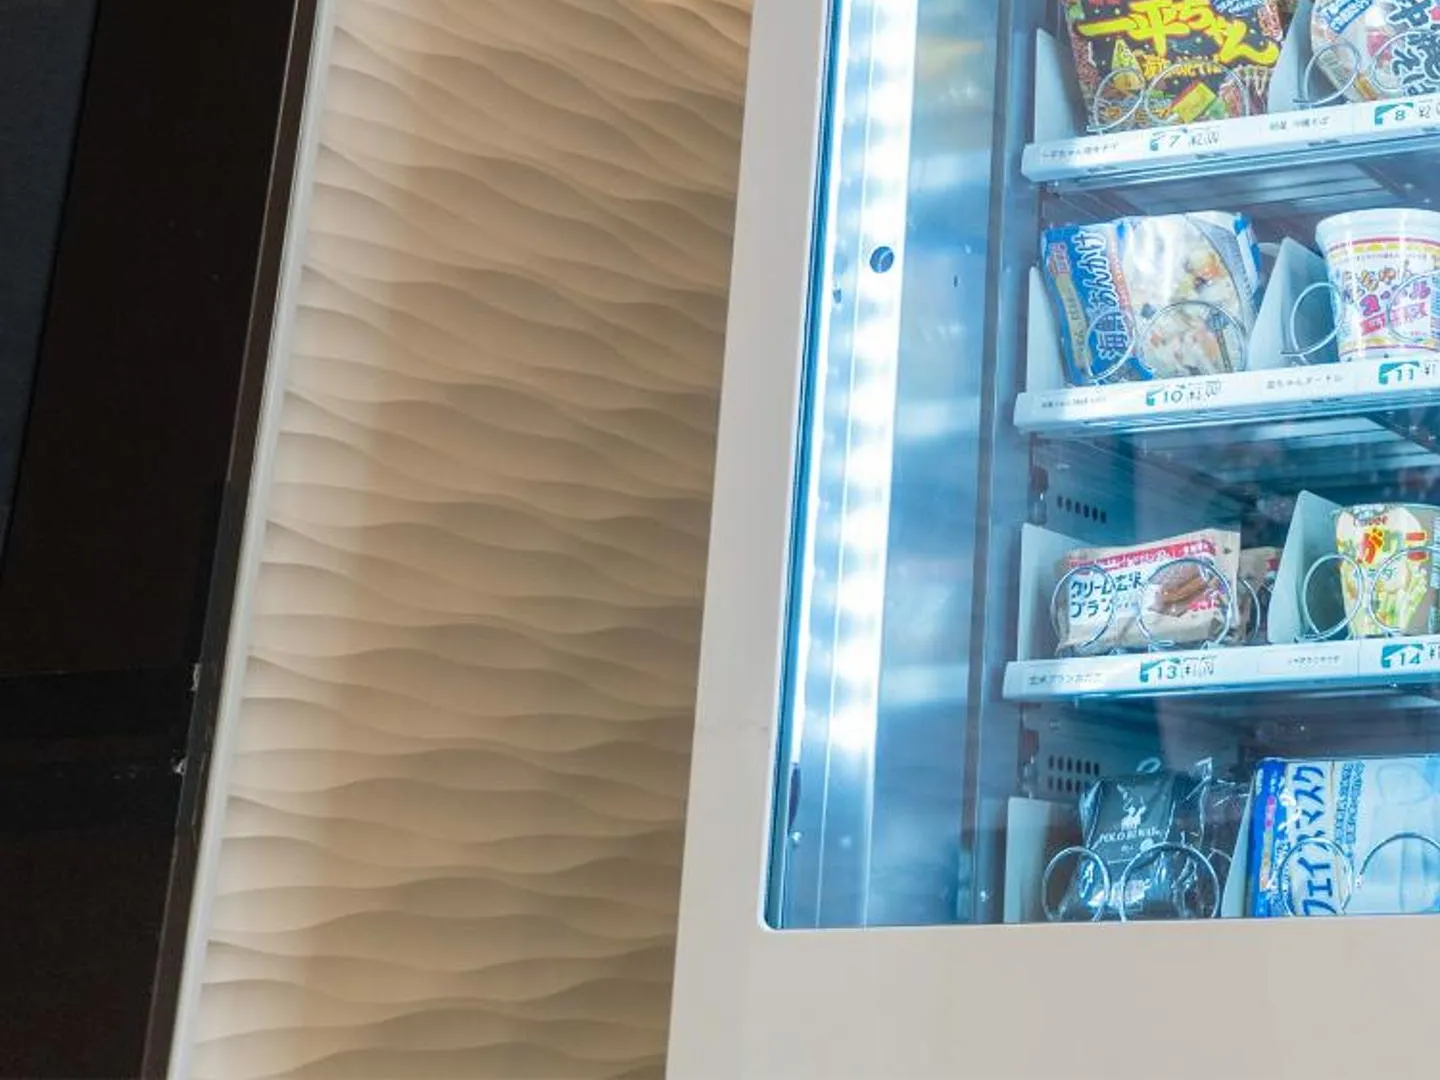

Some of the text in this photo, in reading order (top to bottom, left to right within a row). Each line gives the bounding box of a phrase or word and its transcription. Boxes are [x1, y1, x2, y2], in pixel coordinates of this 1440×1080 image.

[1395, 369, 1414, 382] 11
[1163, 389, 1183, 403] 10
[1398, 652, 1421, 665] 14
[1156, 665, 1177, 680] 13
